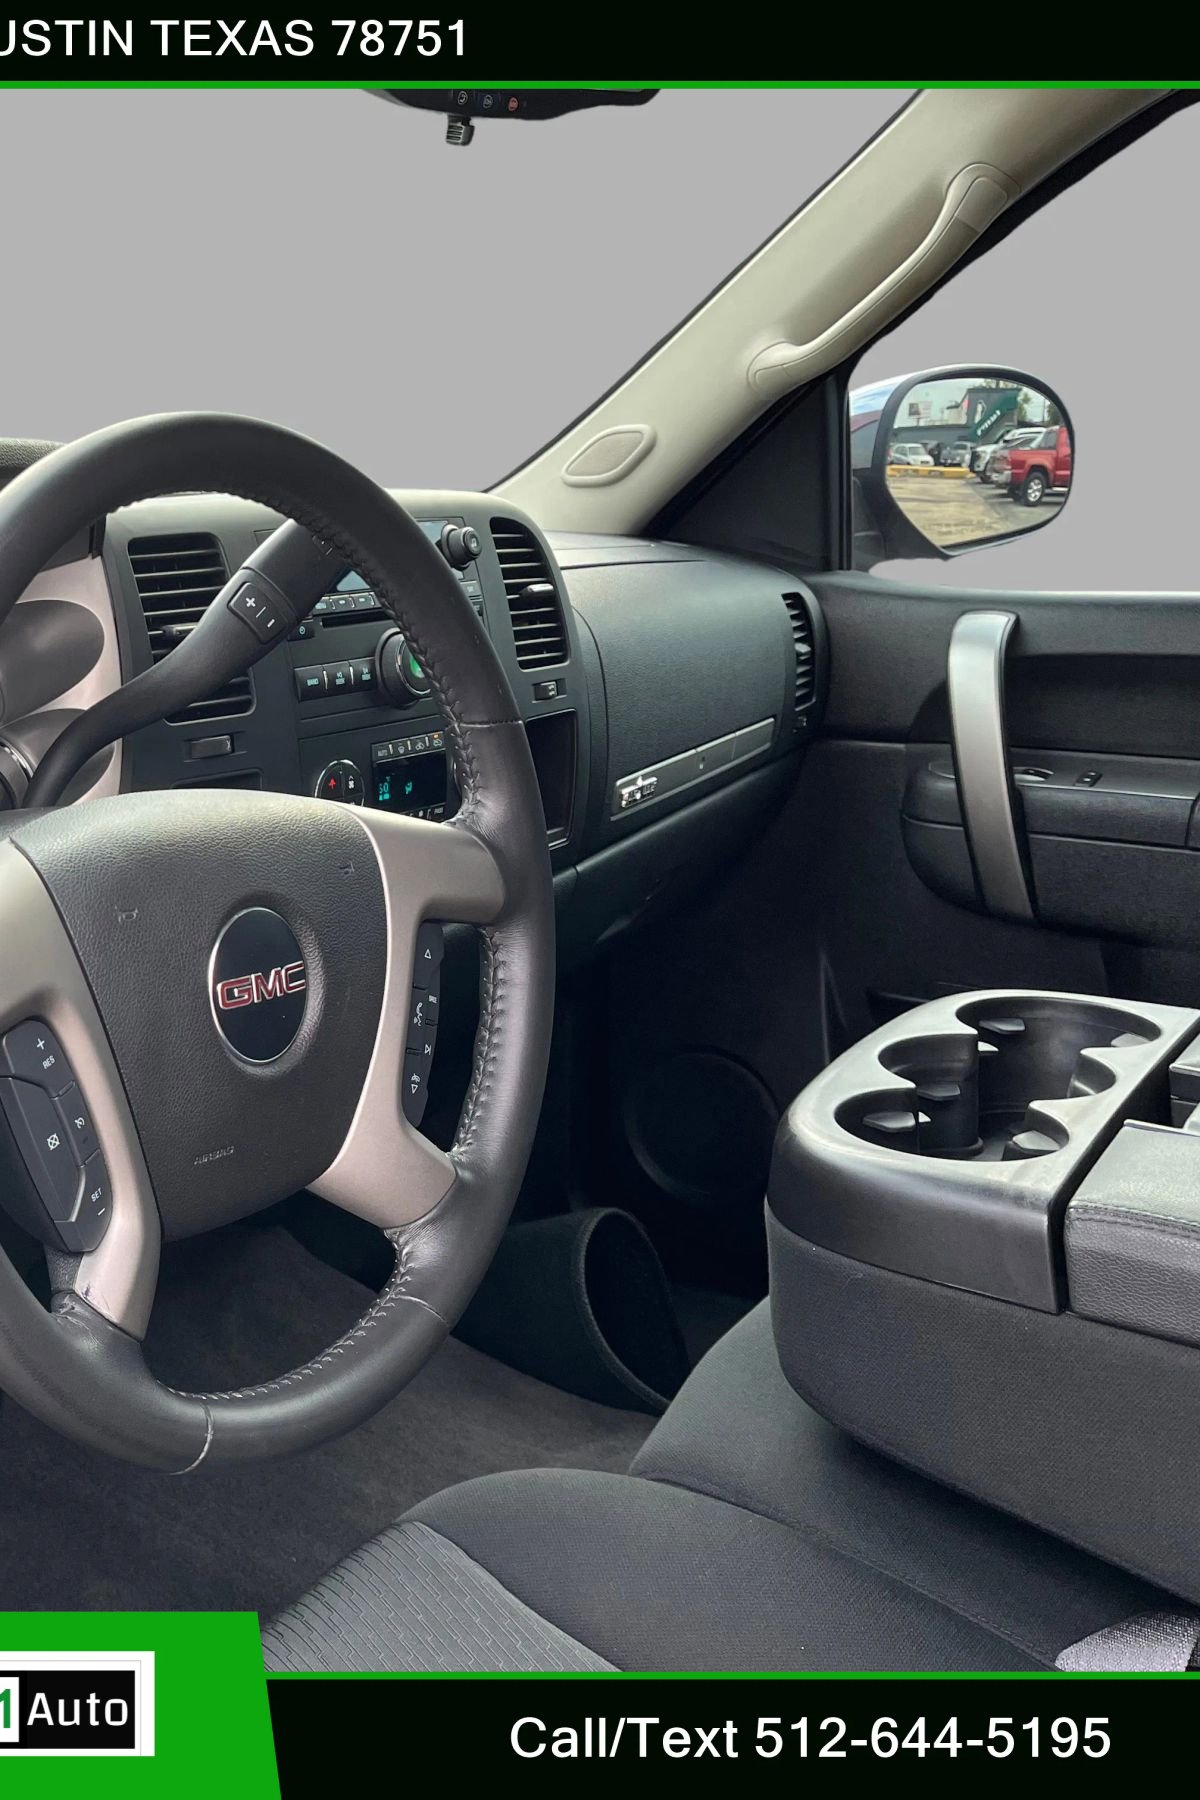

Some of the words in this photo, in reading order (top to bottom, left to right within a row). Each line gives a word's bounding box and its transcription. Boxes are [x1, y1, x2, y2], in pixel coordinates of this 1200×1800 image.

[216, 960, 306, 1010] GMC
[42, 1055, 55, 1070] RES
[91, 1187, 103, 1202] SET
